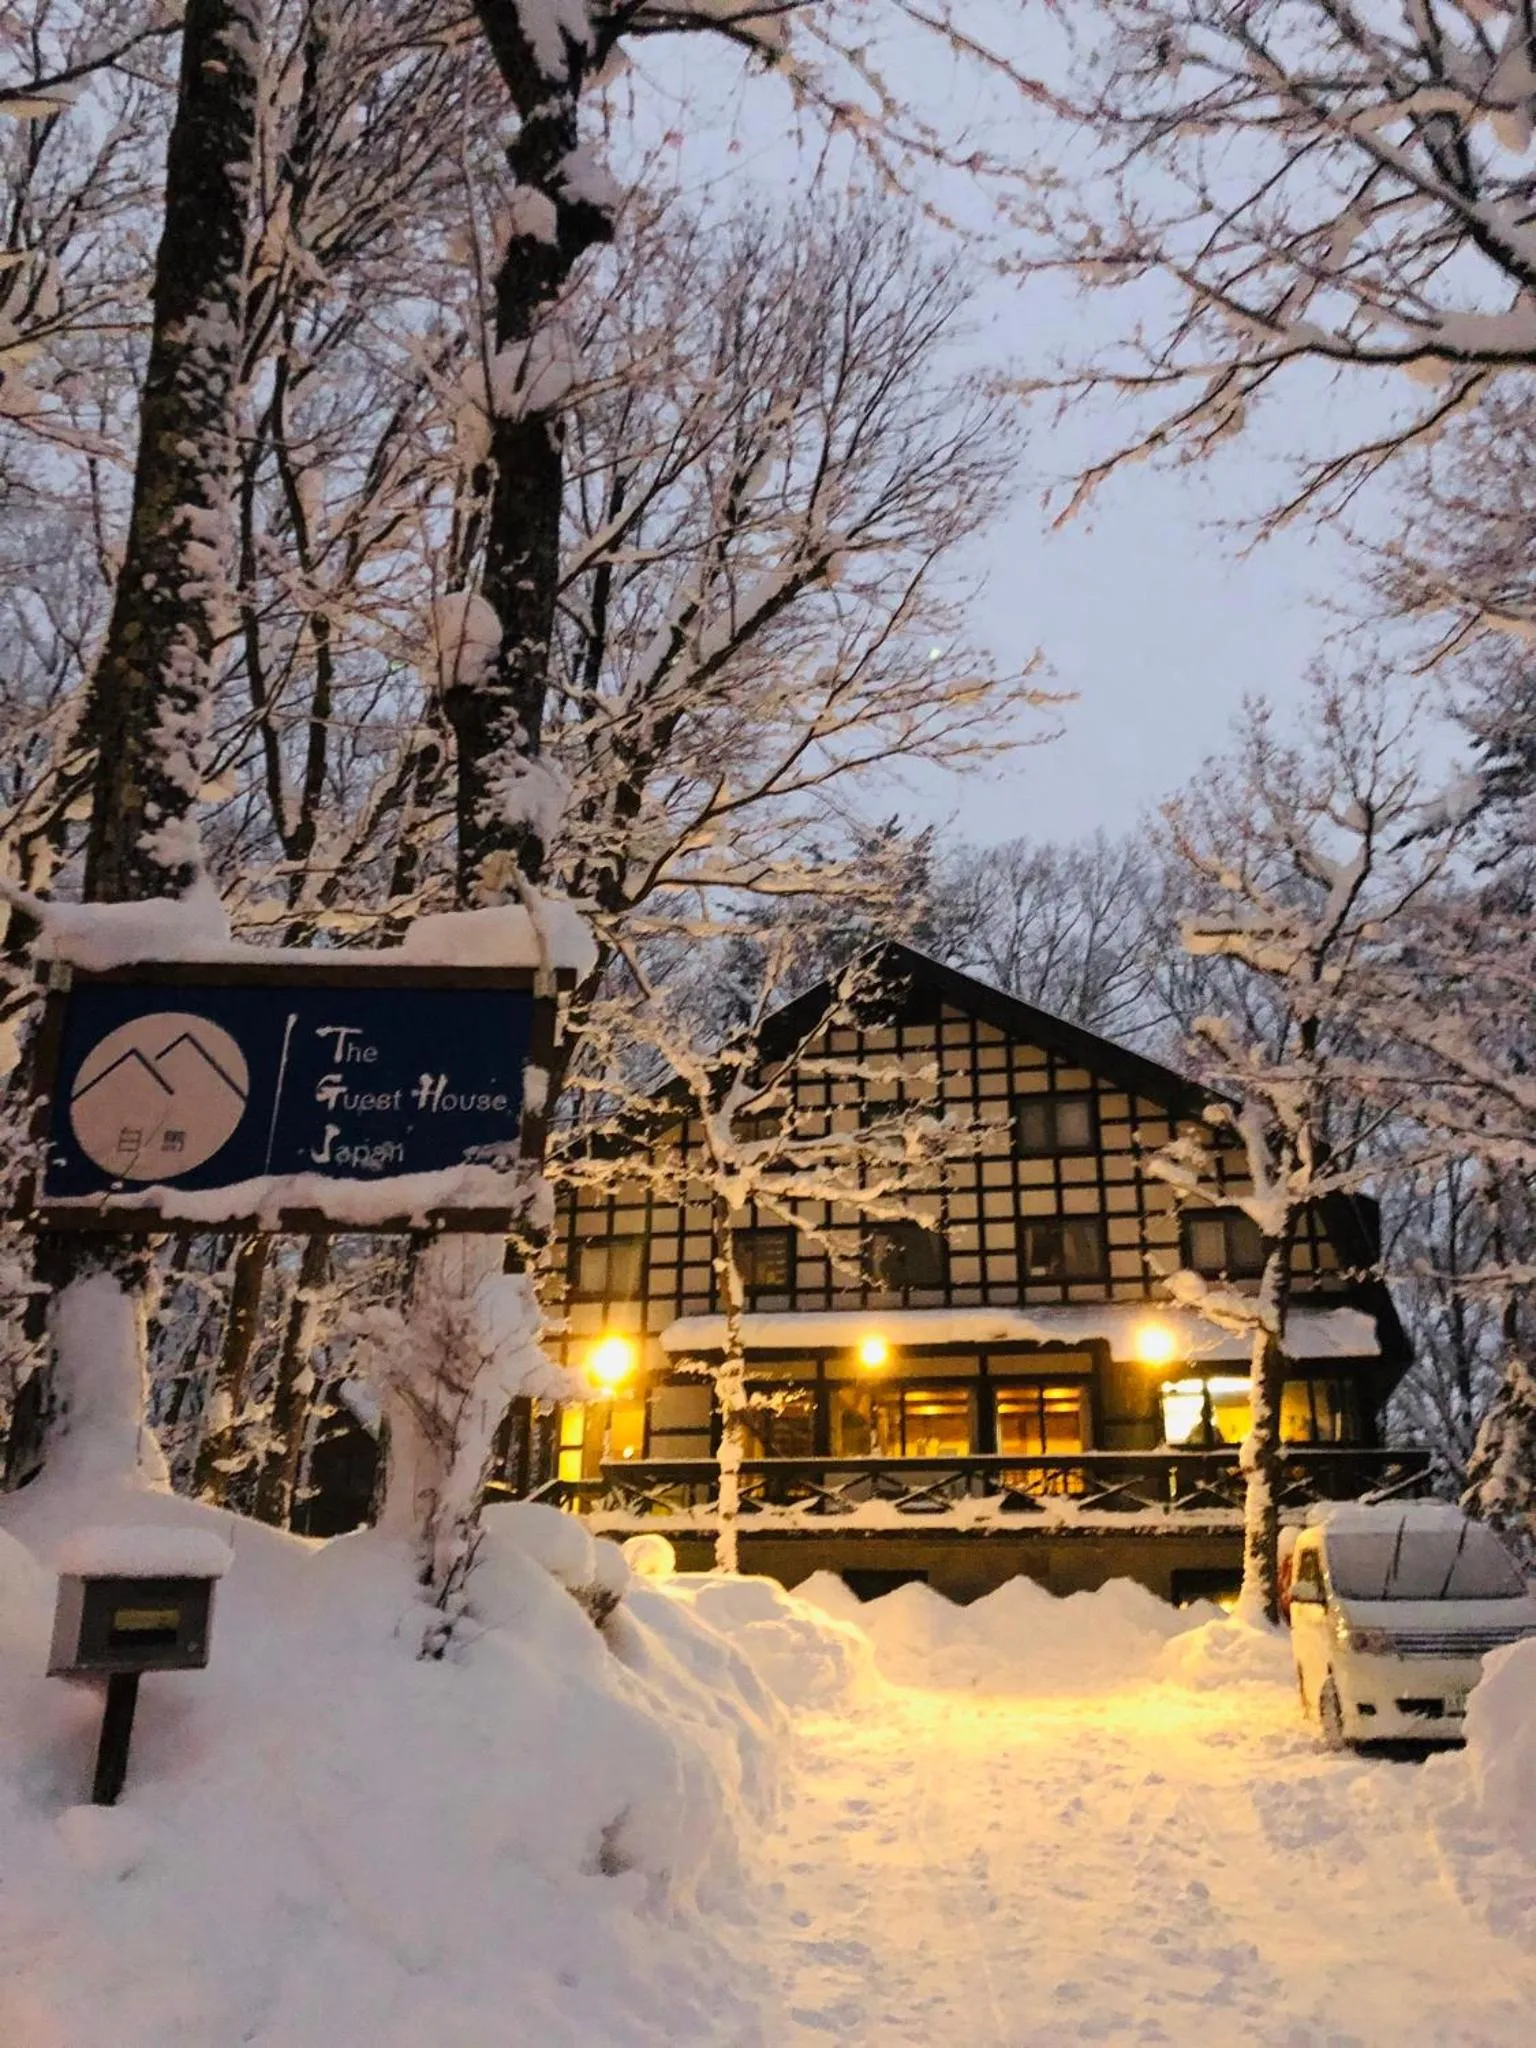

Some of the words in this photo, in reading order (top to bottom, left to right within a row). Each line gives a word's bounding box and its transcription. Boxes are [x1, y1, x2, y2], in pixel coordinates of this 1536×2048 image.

[315, 1026, 379, 1064] The
[315, 1073, 402, 1112] Guest
[411, 1072, 508, 1113] House
[310, 1123, 404, 1168] Japan
